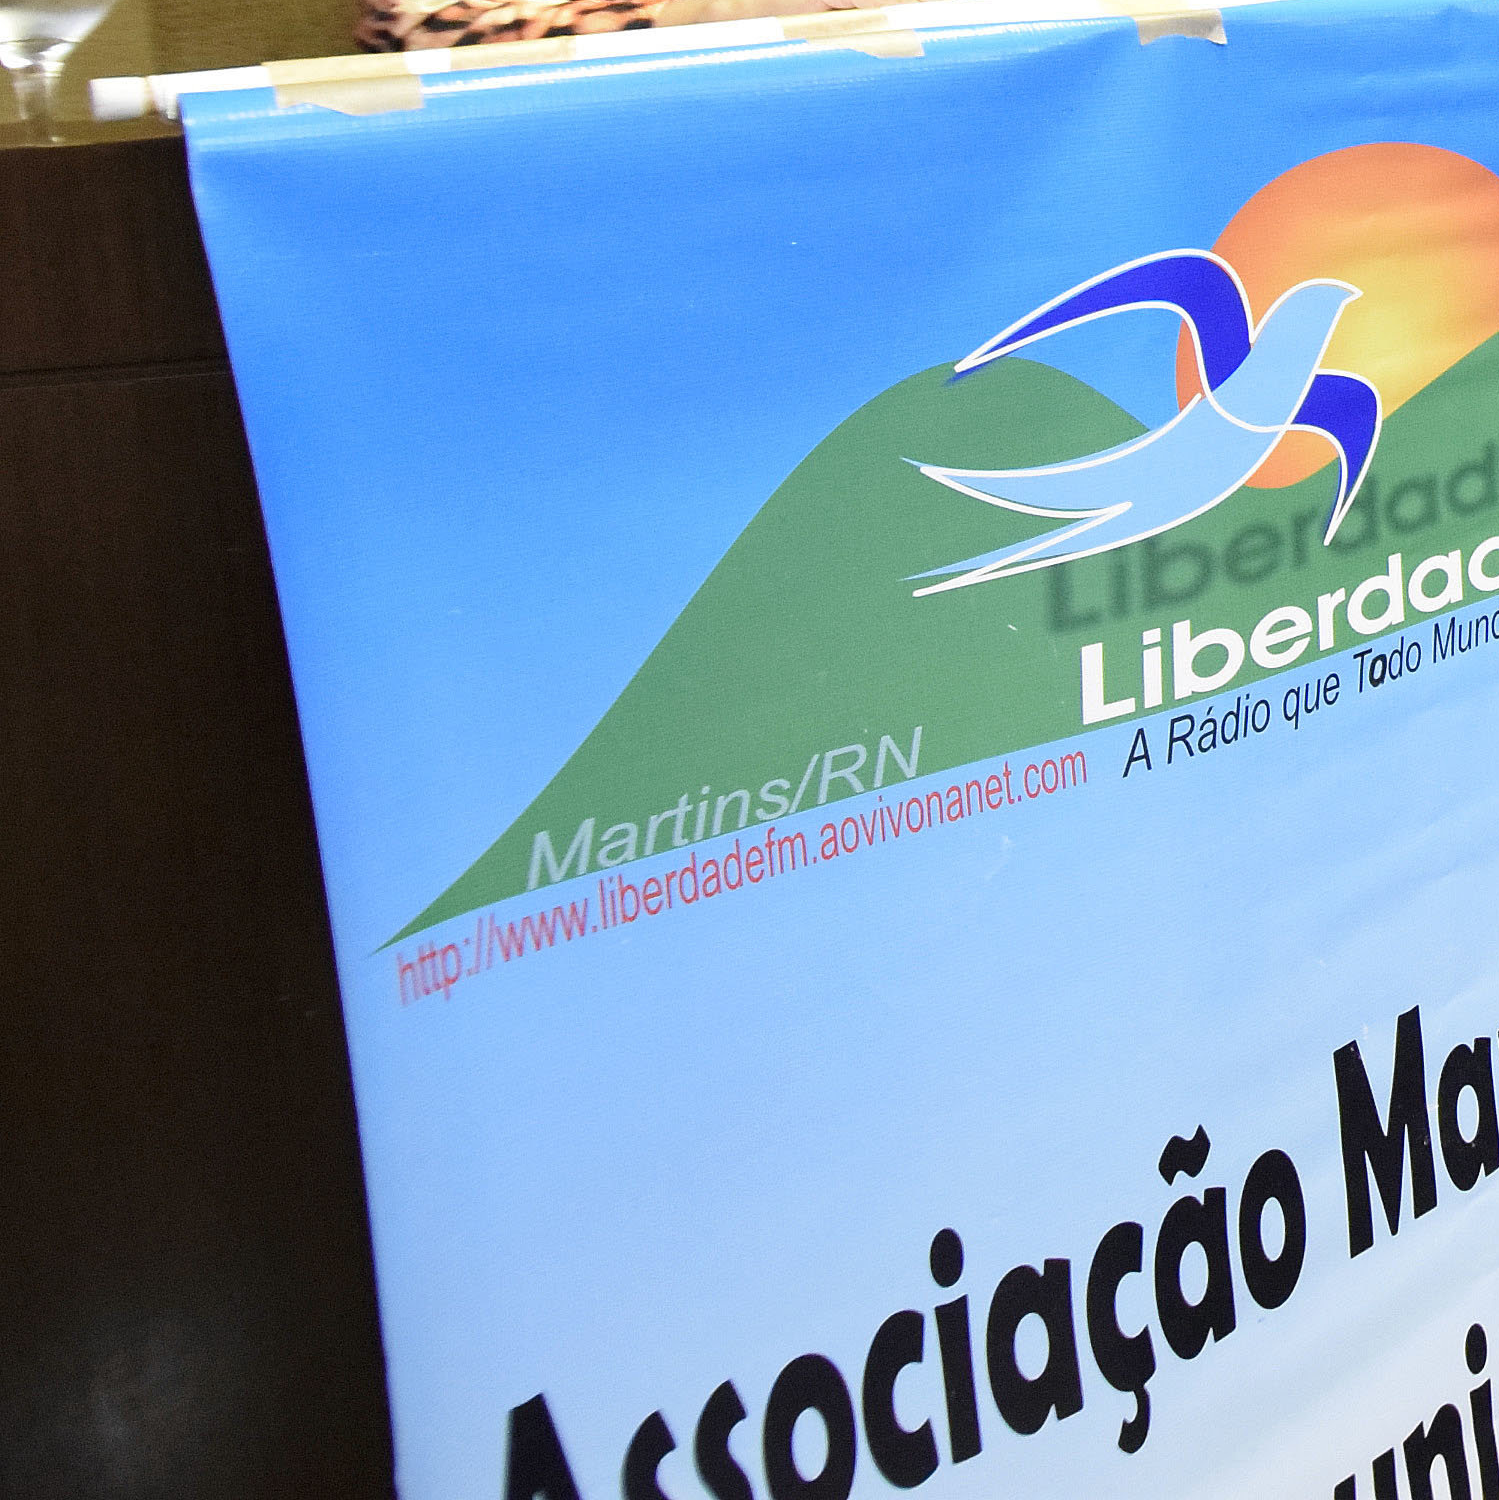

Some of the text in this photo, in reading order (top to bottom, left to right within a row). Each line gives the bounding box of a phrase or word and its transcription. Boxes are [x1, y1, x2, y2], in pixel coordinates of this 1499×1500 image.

[1122, 727, 1153, 779] A
[1167, 693, 1271, 765] Rádio
[1283, 672, 1341, 731] que
[1354, 636, 1422, 694] Todo
[397, 749, 1089, 1007] http://www.liberdadefm.aovivonanet.com
[525, 726, 924, 891] Martins/RN
